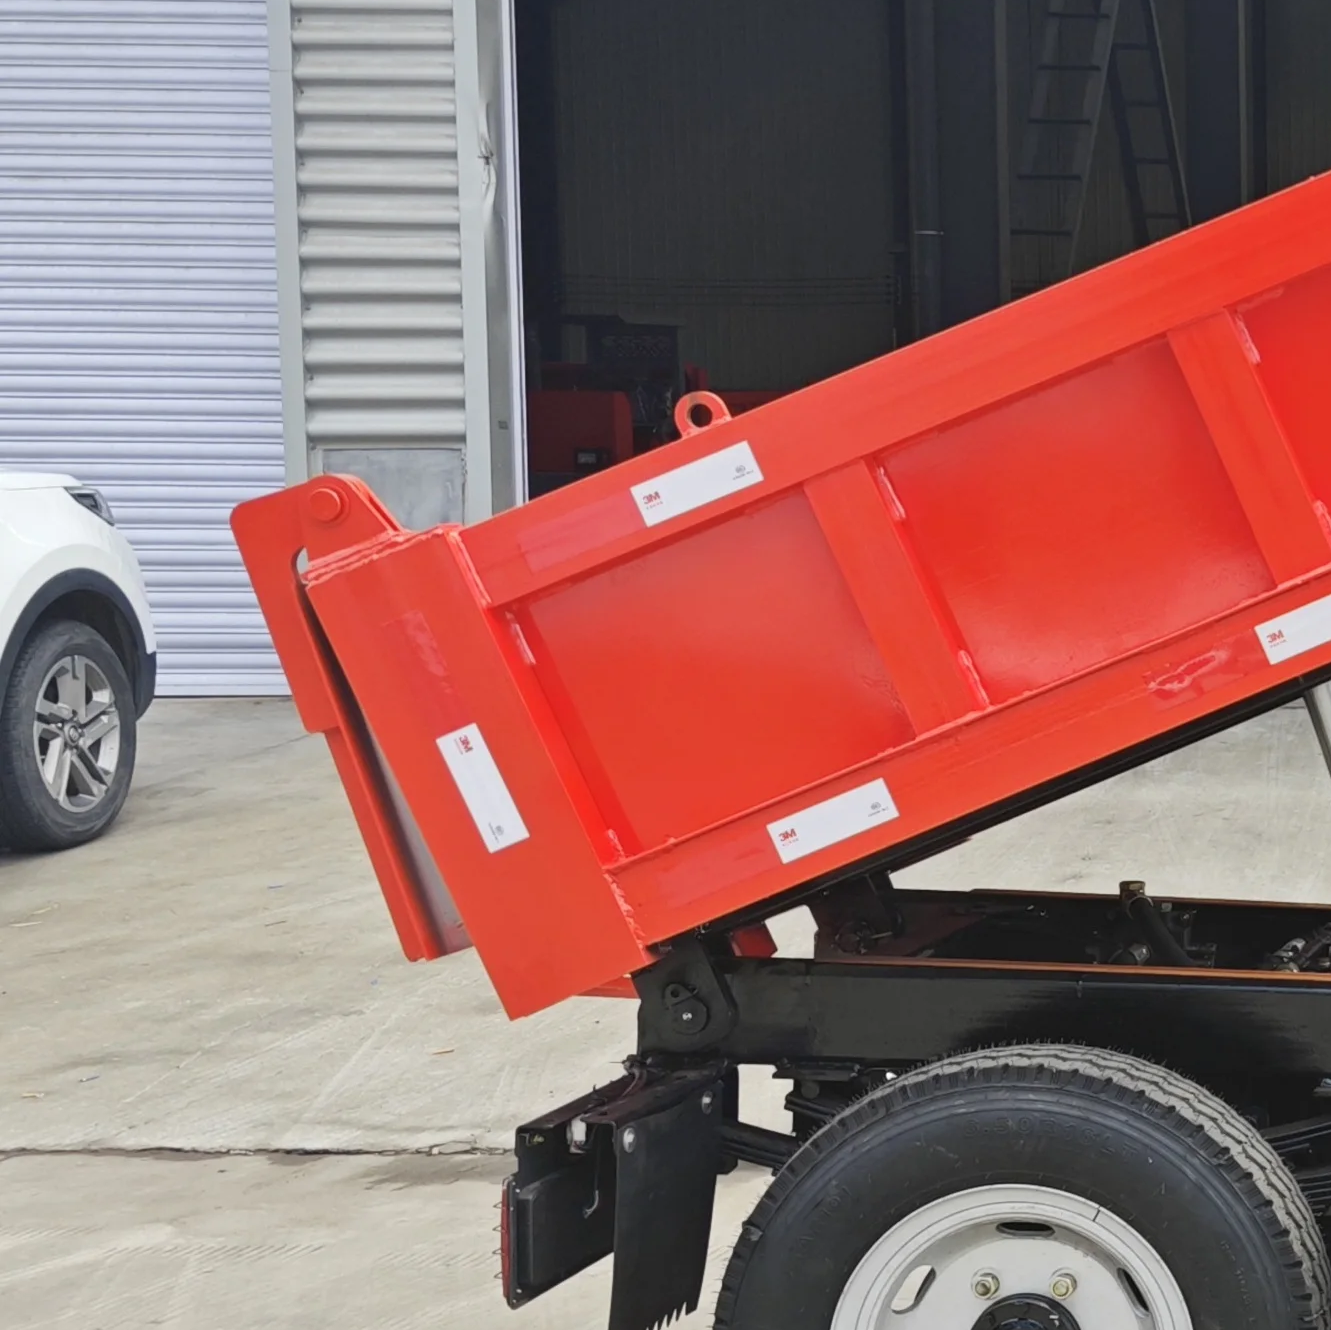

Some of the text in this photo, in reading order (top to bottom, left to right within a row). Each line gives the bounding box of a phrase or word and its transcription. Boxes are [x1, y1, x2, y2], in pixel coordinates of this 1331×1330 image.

[643, 491, 661, 505] 3M
[1266, 629, 1285, 643] 3M
[459, 734, 473, 753] 3M
[779, 828, 797, 842] 3M
